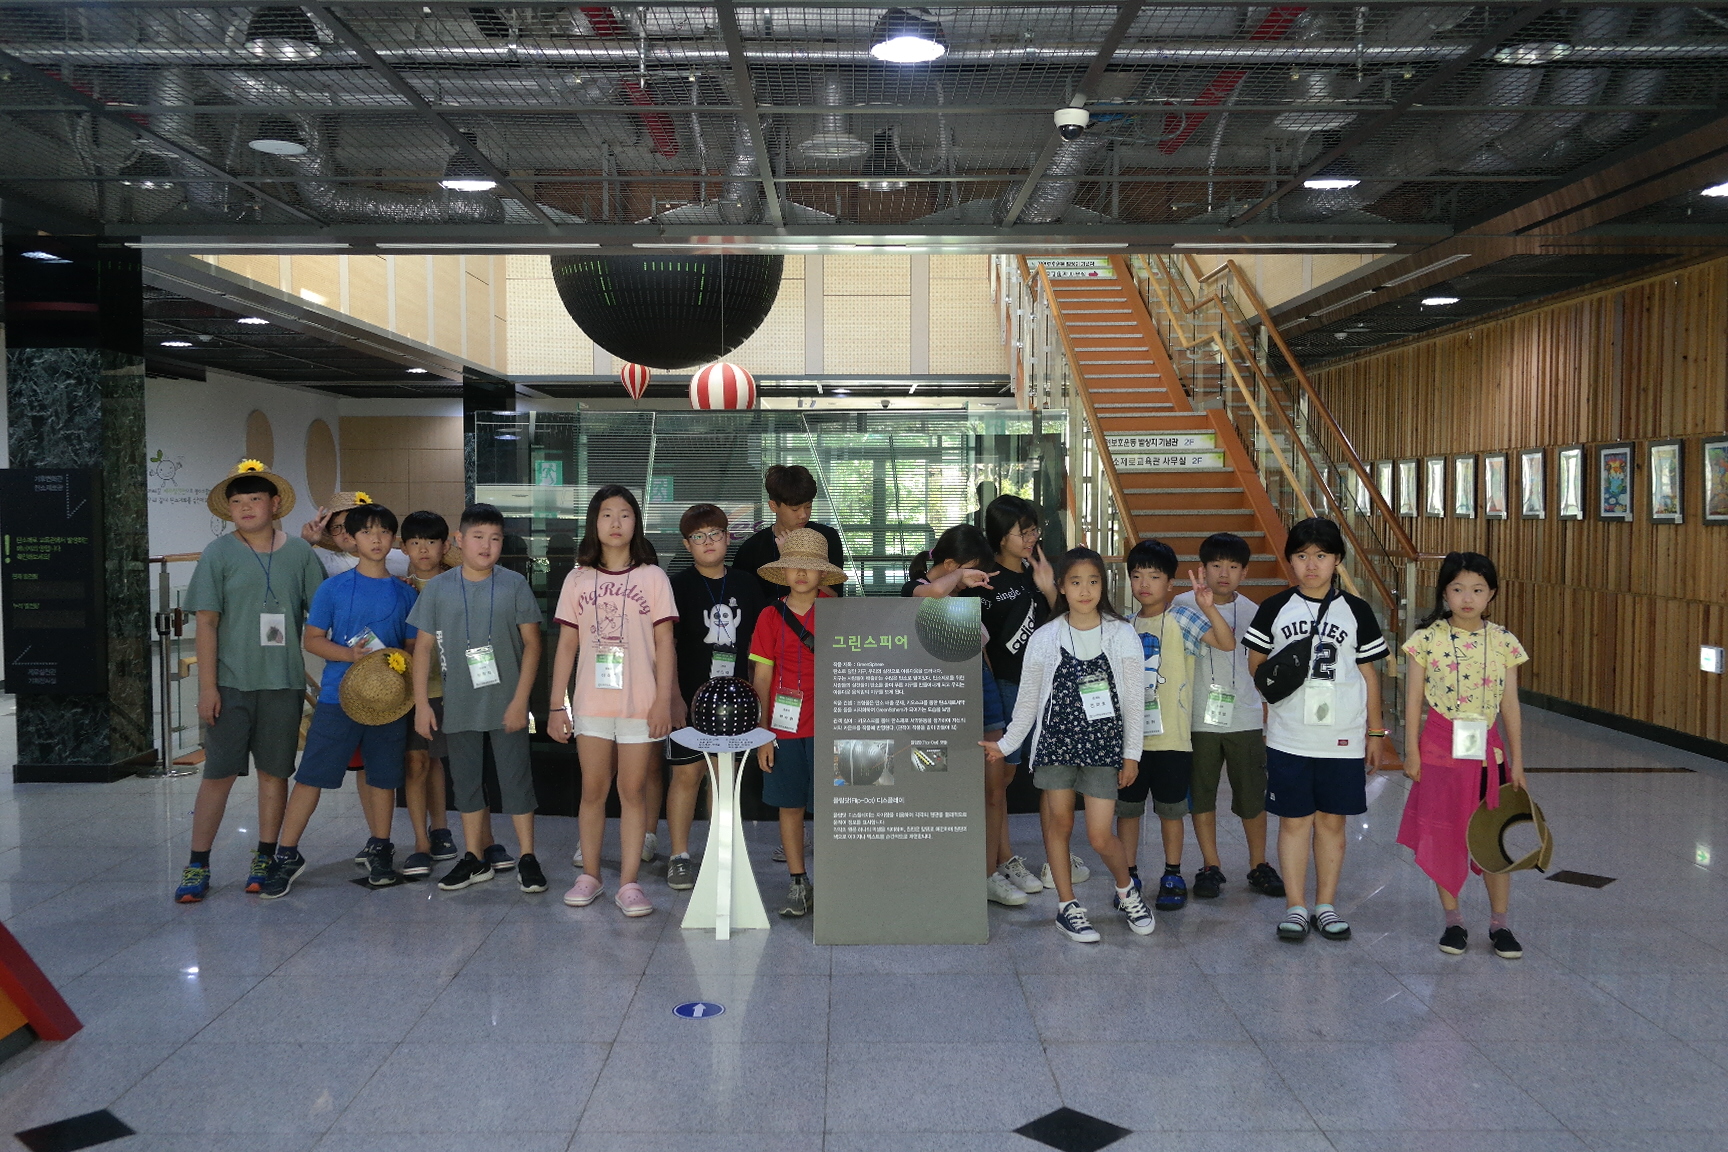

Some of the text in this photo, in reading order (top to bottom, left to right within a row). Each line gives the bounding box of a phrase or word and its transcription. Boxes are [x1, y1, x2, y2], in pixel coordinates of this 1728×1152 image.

[1138, 438, 1158, 447] 발상지
[1158, 438, 1179, 447] 기념관
[1184, 438, 1195, 446] 2F
[1162, 457, 1187, 466] 사무실
[1192, 457, 1203, 465] 2F
[598, 581, 651, 615] Riding
[995, 587, 1021, 602] single
[832, 635, 908, 652] 그린스피어
[1311, 641, 1338, 682] 2
